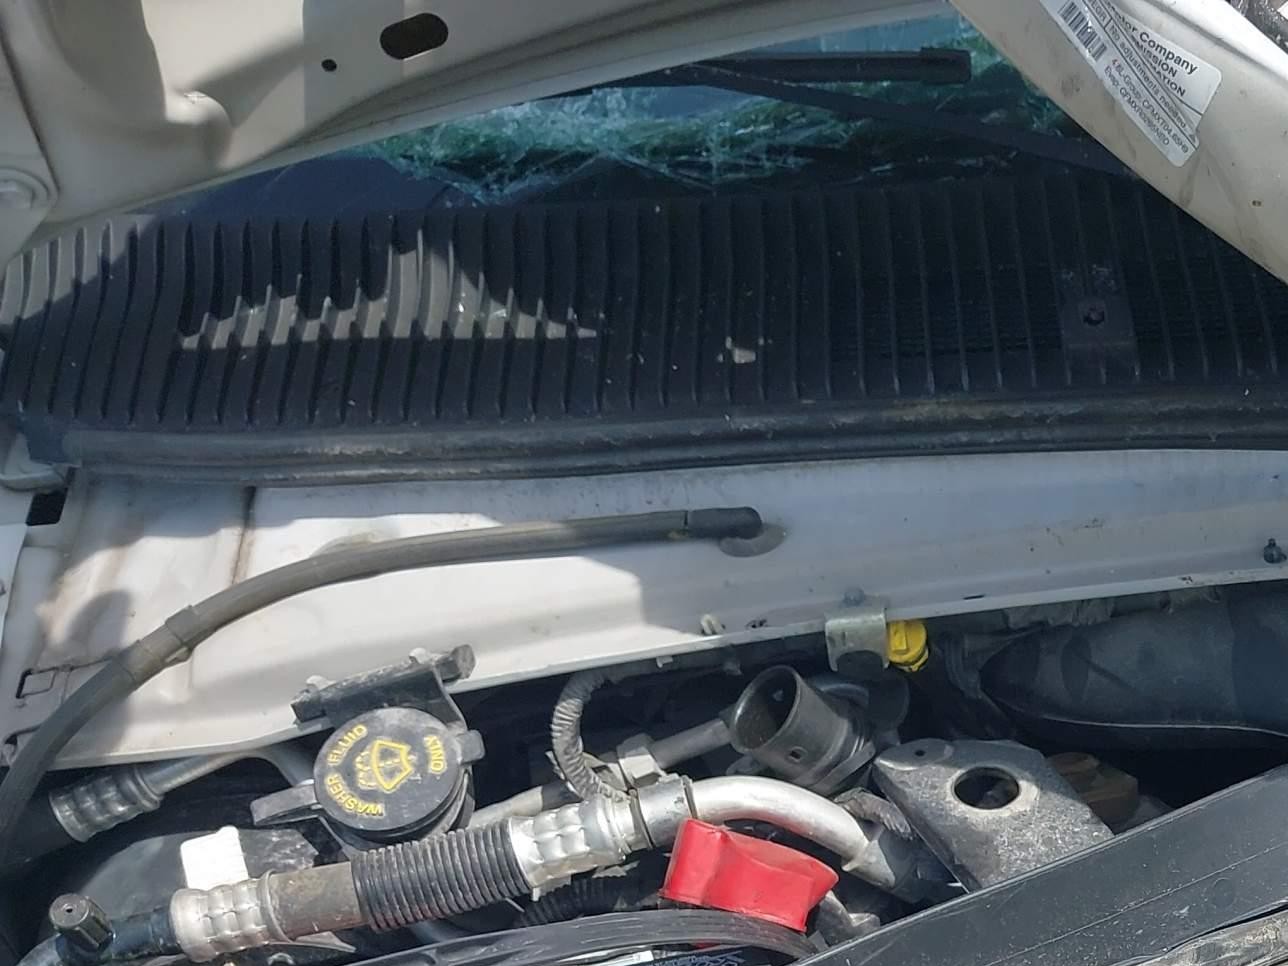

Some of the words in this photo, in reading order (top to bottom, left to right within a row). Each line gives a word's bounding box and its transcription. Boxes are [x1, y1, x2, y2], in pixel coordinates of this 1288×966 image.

[1120, 41, 1161, 95] adjustments
[1140, 31, 1198, 75] Company
[328, 724, 367, 766] FLUID
[423, 735, 445, 773] ONLY
[325, 774, 385, 817] WASHER
